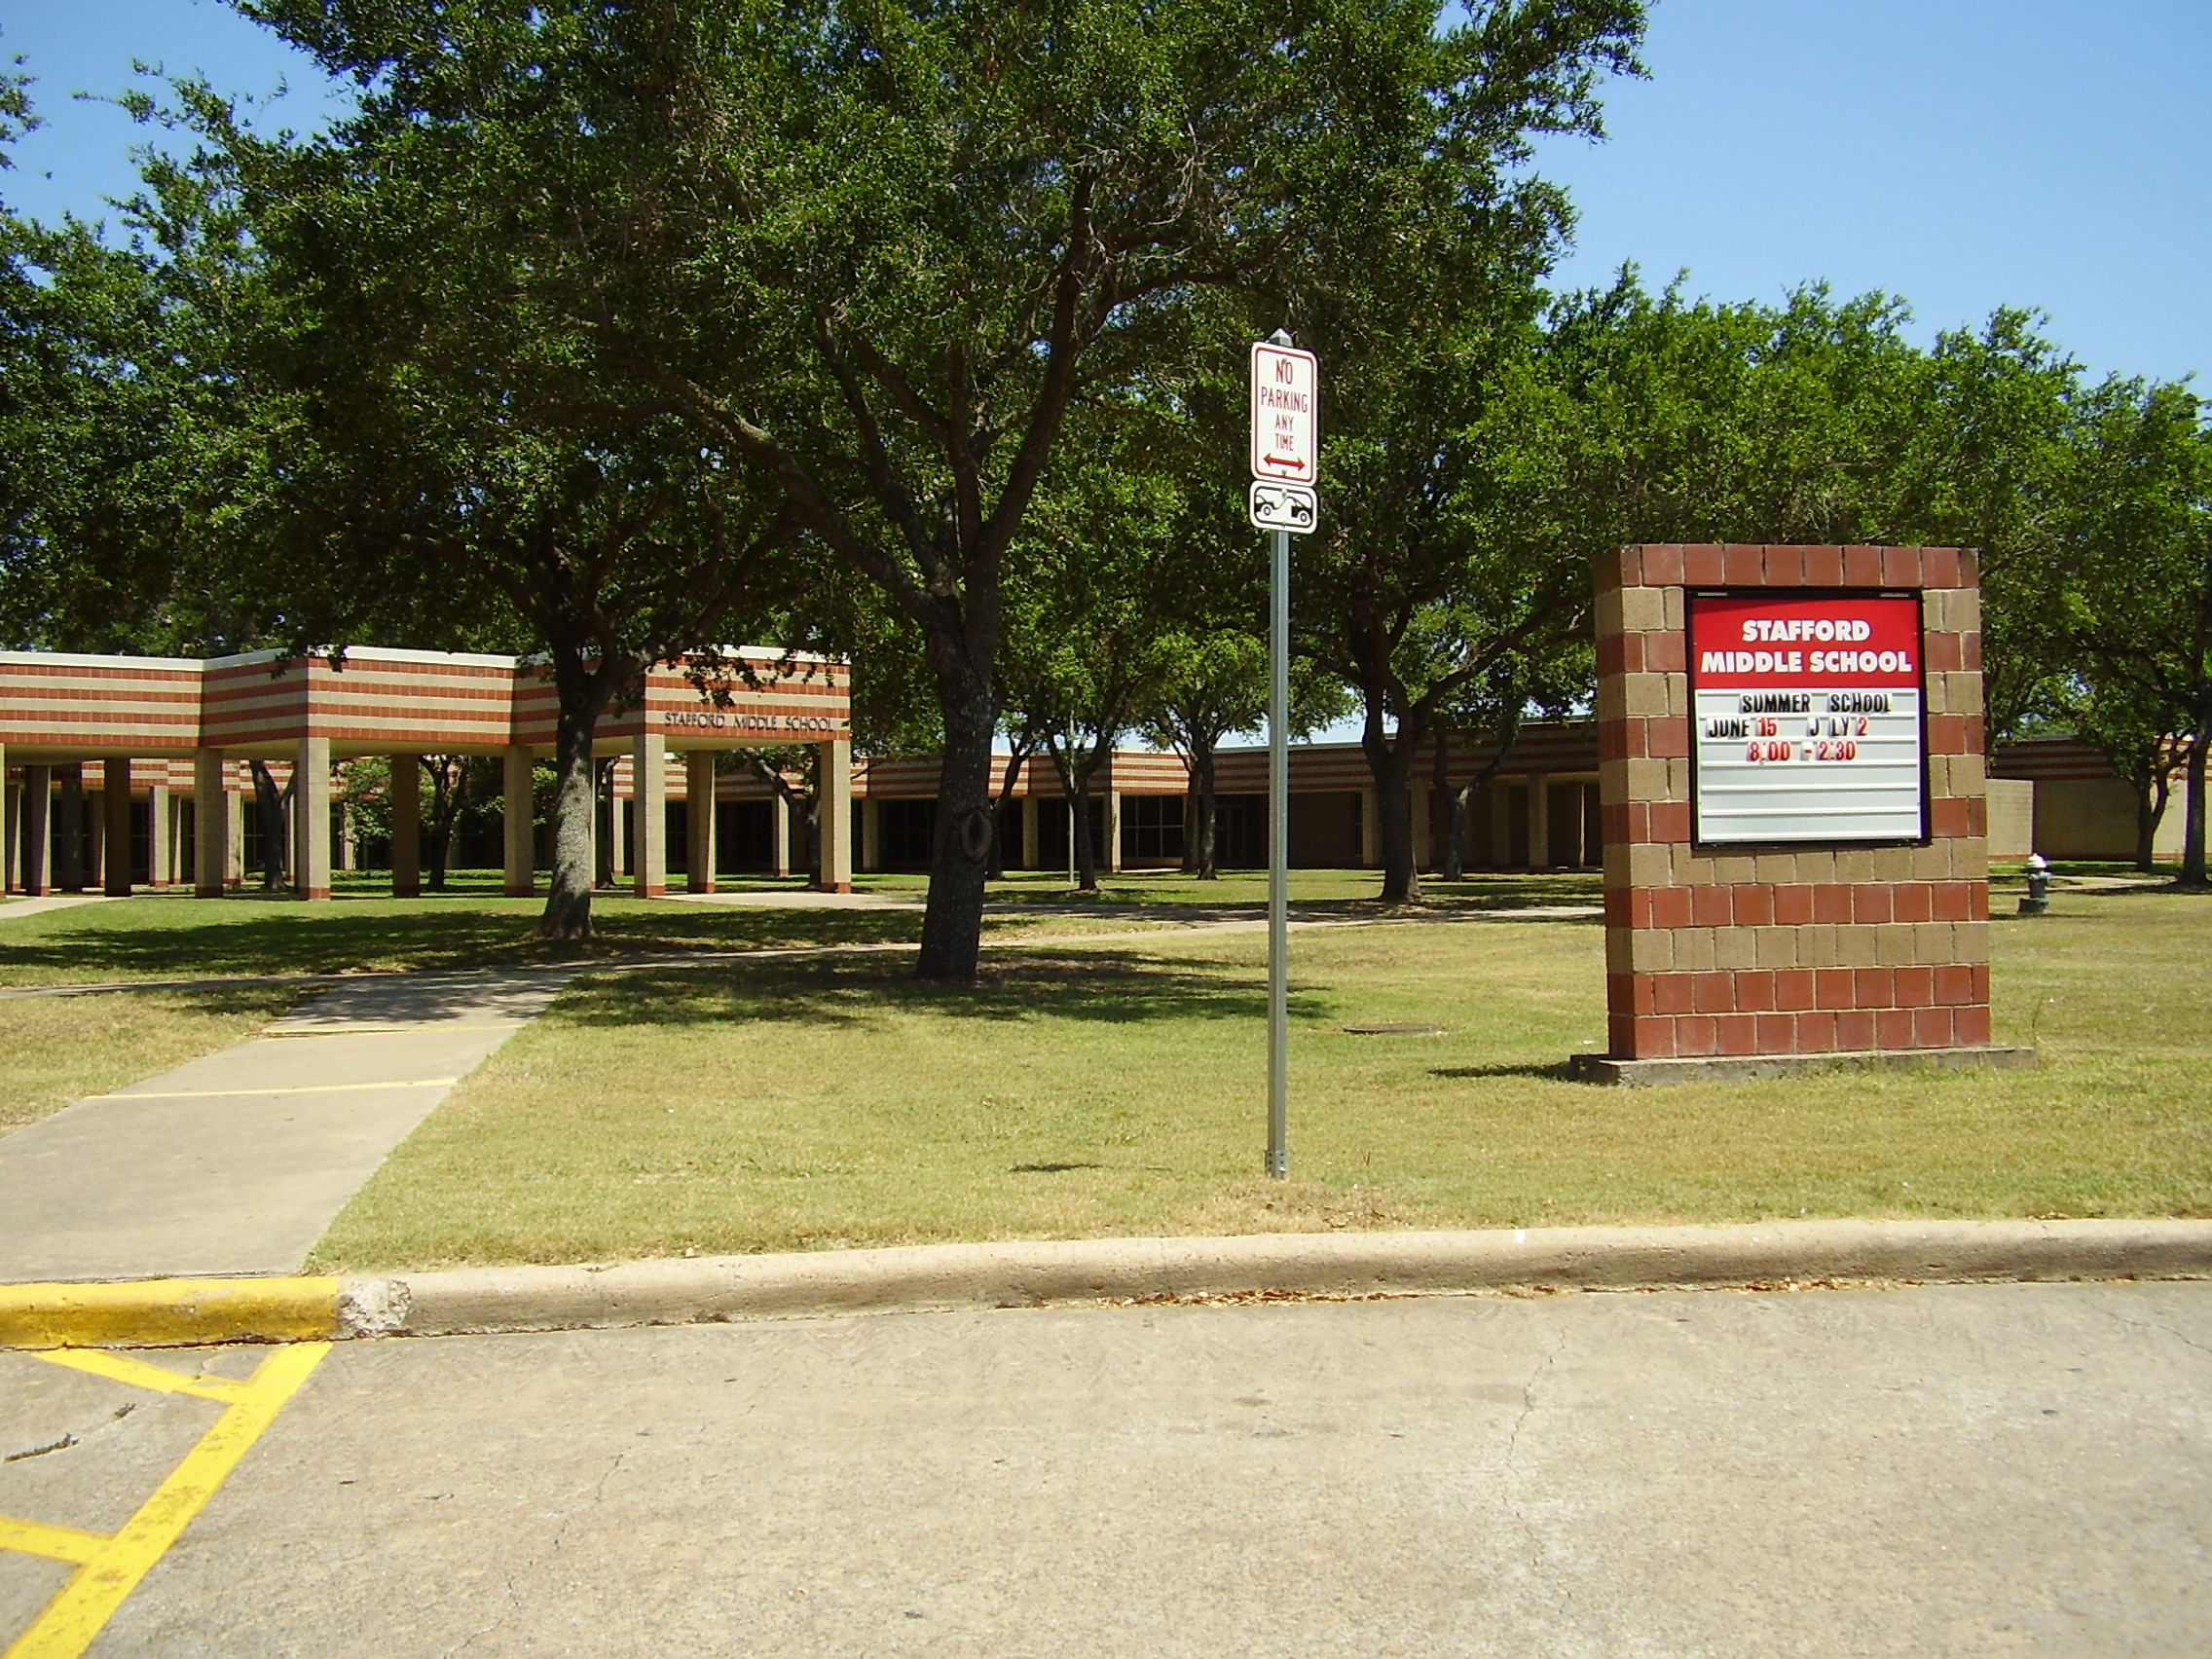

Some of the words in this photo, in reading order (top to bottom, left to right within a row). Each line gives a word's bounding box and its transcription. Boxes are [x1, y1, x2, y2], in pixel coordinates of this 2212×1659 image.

[1275, 359, 1294, 386] NO
[1261, 386, 1309, 413] PARKING
[1274, 414, 1295, 432] ANY
[1275, 432, 1295, 452] TIME
[1742, 619, 1870, 642] STAFFORD
[1701, 651, 1802, 673] MIDDLE
[1809, 650, 1912, 673] SCHOOL
[1742, 694, 1811, 714] SUMMER
[1829, 693, 1892, 714] SCHOOL
[664, 712, 726, 729] STAFFORD
[732, 715, 778, 731] MIDDLE
[784, 717, 834, 732] SCHOOL
[1708, 718, 1750, 738] JUNE
[1756, 717, 1778, 737] 15
[1858, 717, 1868, 737] 2
[1749, 742, 1790, 762] 8:00
[1818, 742, 1857, 761] 2:30
